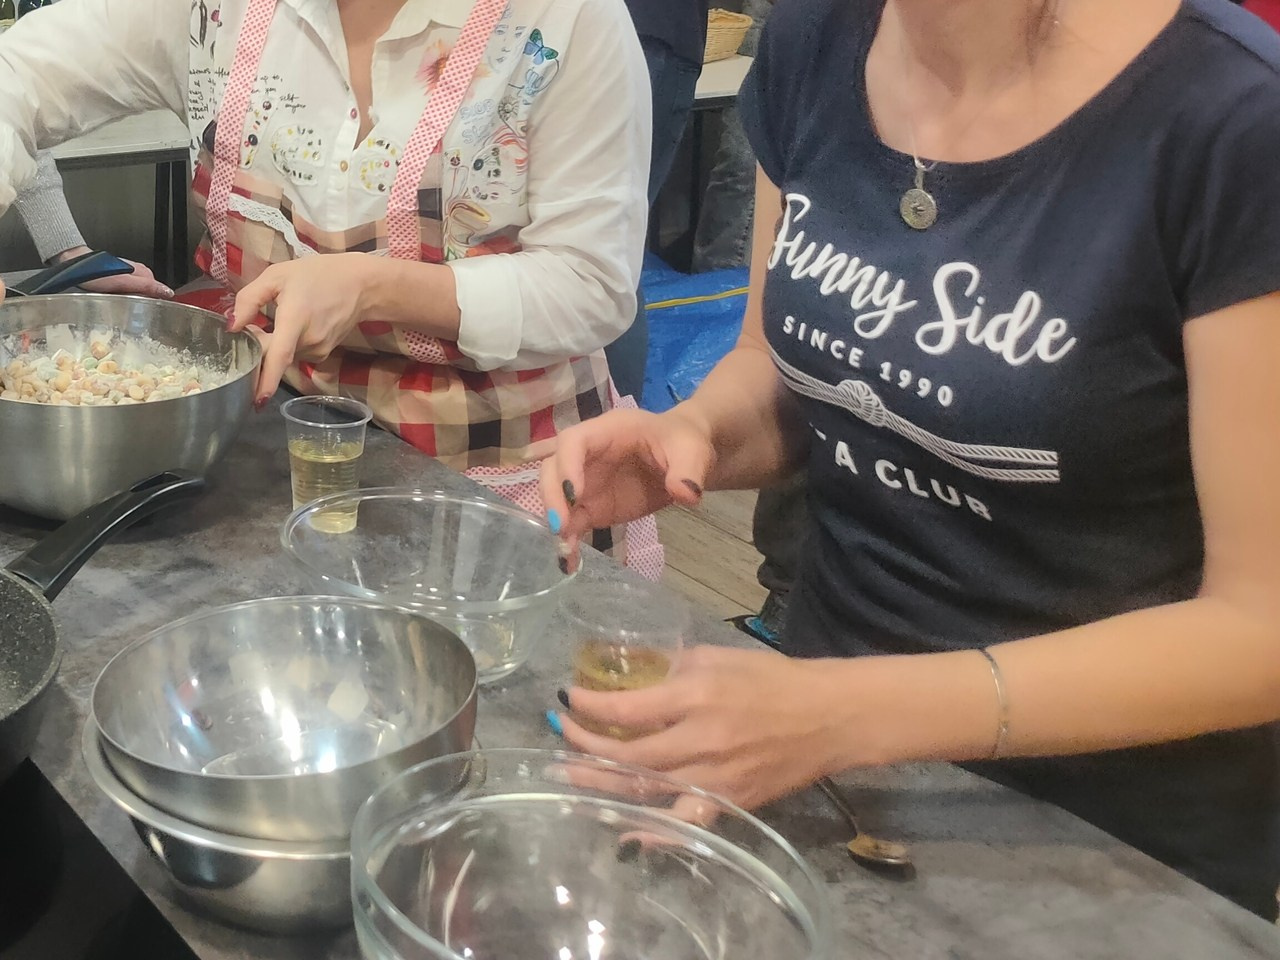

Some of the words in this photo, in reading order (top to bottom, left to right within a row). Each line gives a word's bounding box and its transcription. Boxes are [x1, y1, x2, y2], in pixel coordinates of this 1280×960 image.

[767, 193, 918, 339] Funny
[915, 261, 1077, 367] Side
[782, 315, 865, 369] SINCE
[879, 361, 954, 407] 1990
